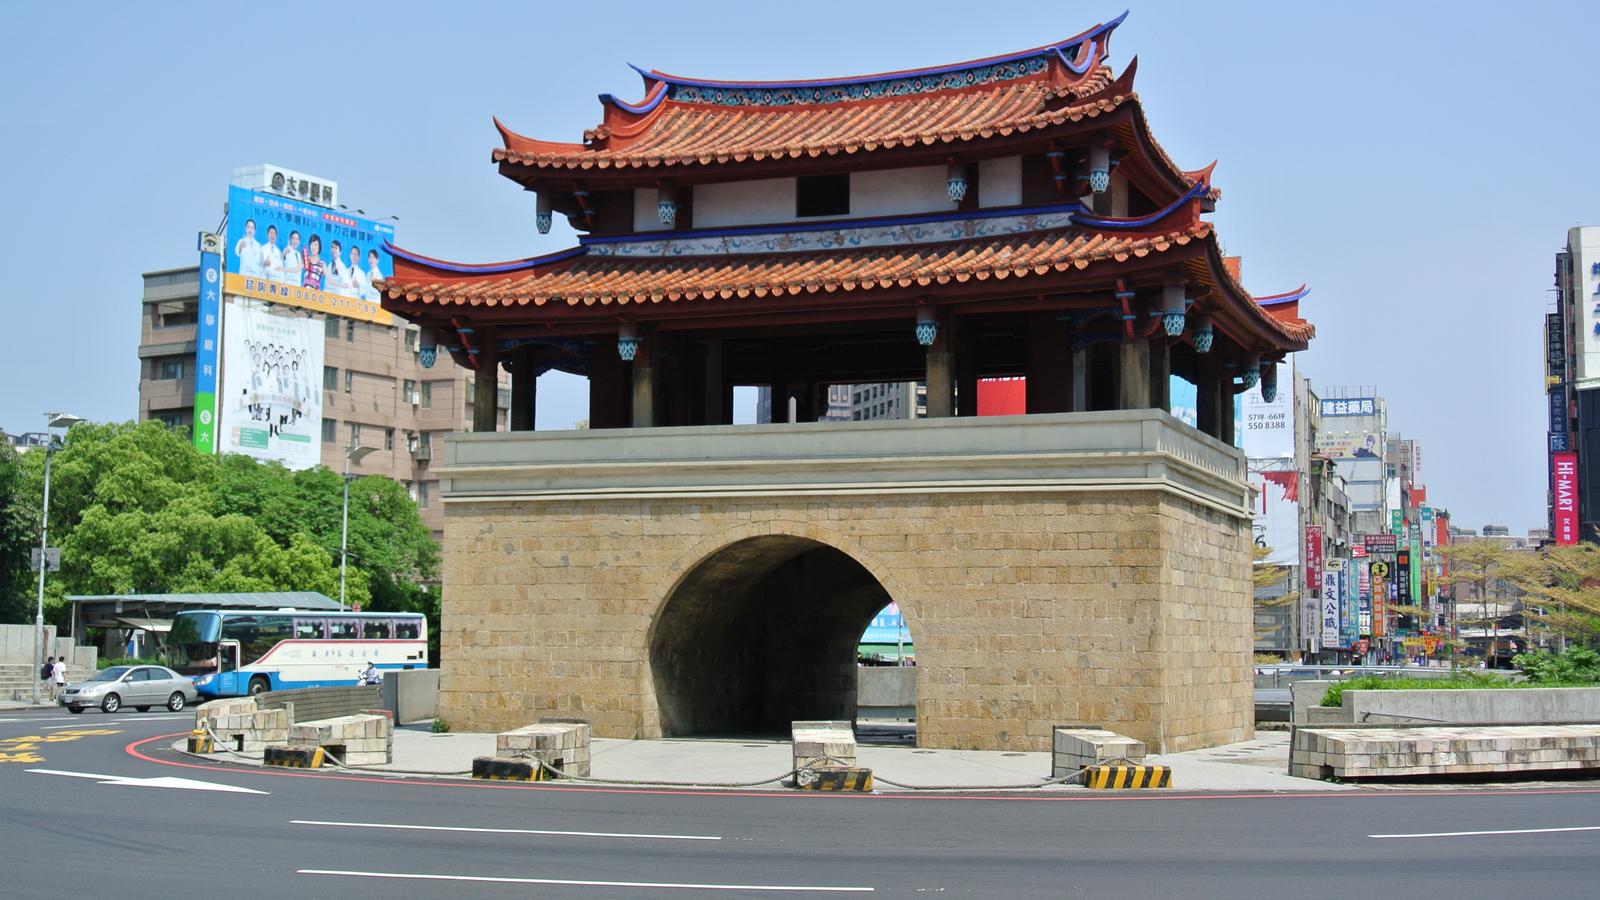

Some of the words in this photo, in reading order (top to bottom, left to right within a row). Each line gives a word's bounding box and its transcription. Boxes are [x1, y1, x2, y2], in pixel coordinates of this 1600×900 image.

[203, 288, 216, 376] 大學眼科
[1322, 400, 1373, 415] 建益藥局
[199, 429, 210, 443] 大
[1248, 421, 1264, 430] 550
[1265, 421, 1287, 429] 8388
[1557, 462, 1574, 512] Hi-MART
[1324, 573, 1338, 630] 鼎文公職
